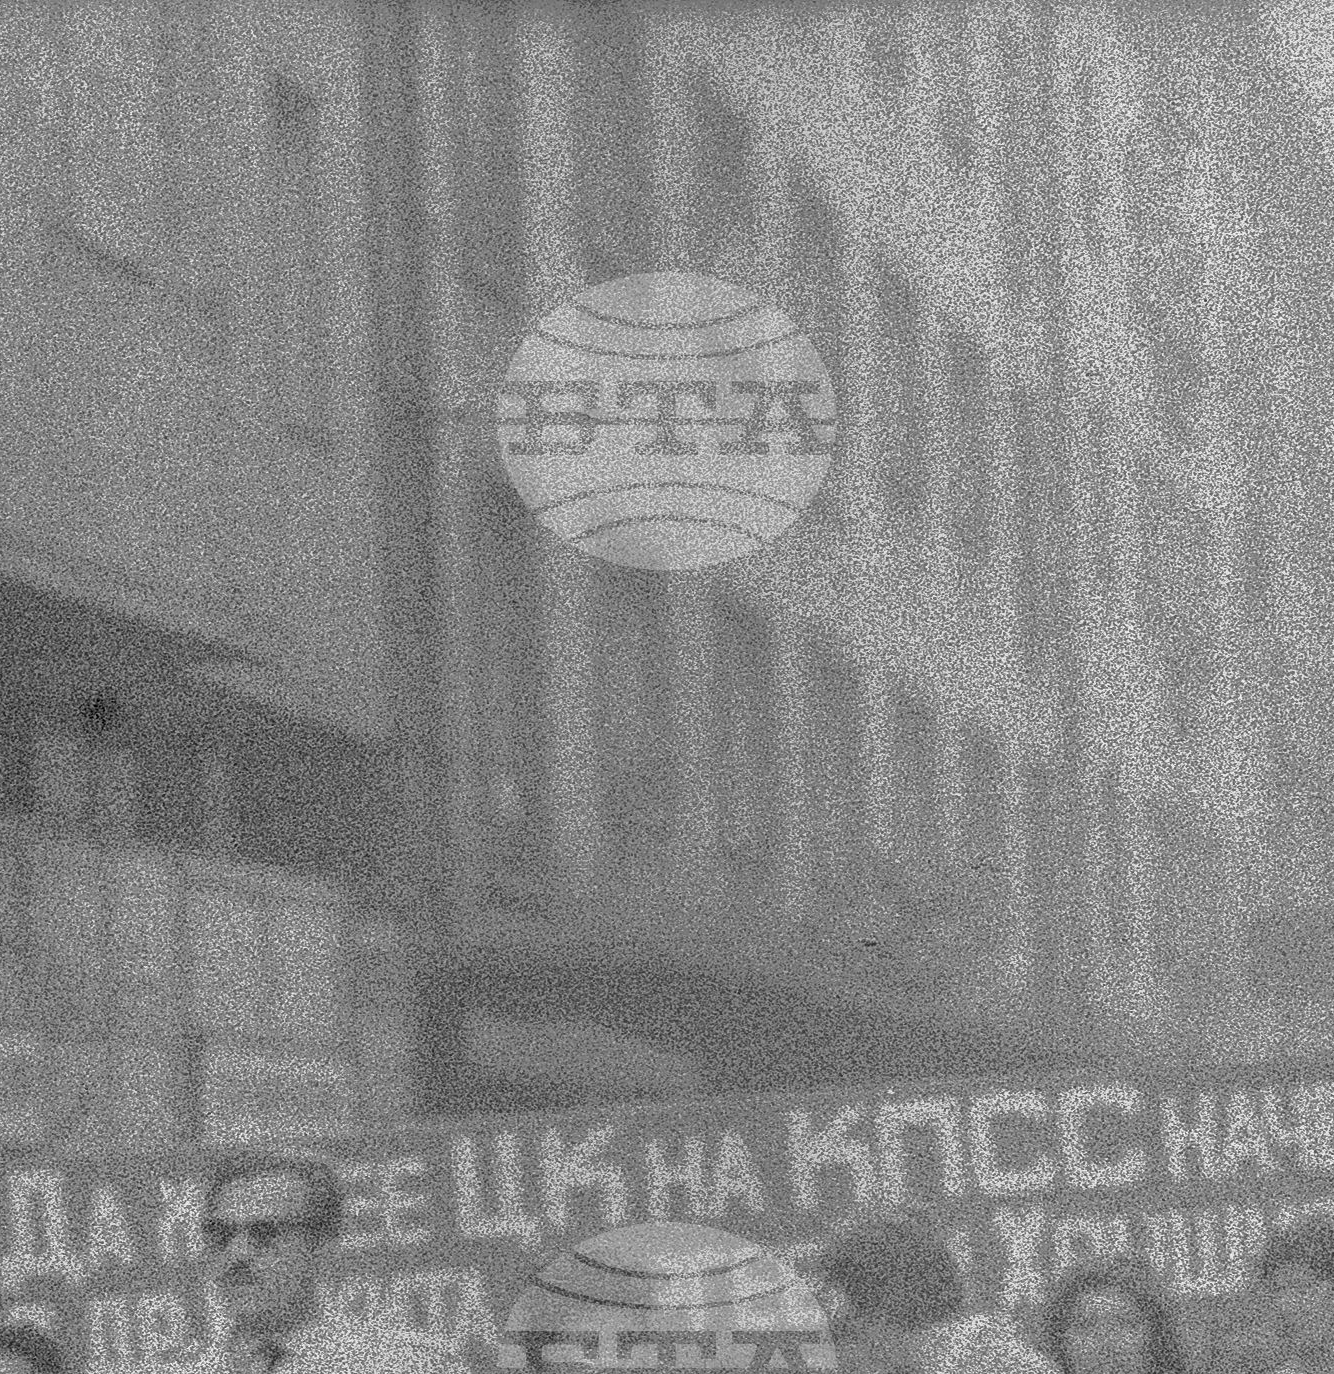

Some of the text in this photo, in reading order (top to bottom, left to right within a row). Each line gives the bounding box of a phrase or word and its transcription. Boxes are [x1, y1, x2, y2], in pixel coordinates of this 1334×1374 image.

[451, 1122, 629, 1248] ЦК
[644, 1129, 764, 1219] НА
[786, 1080, 1149, 1209] КПСС
